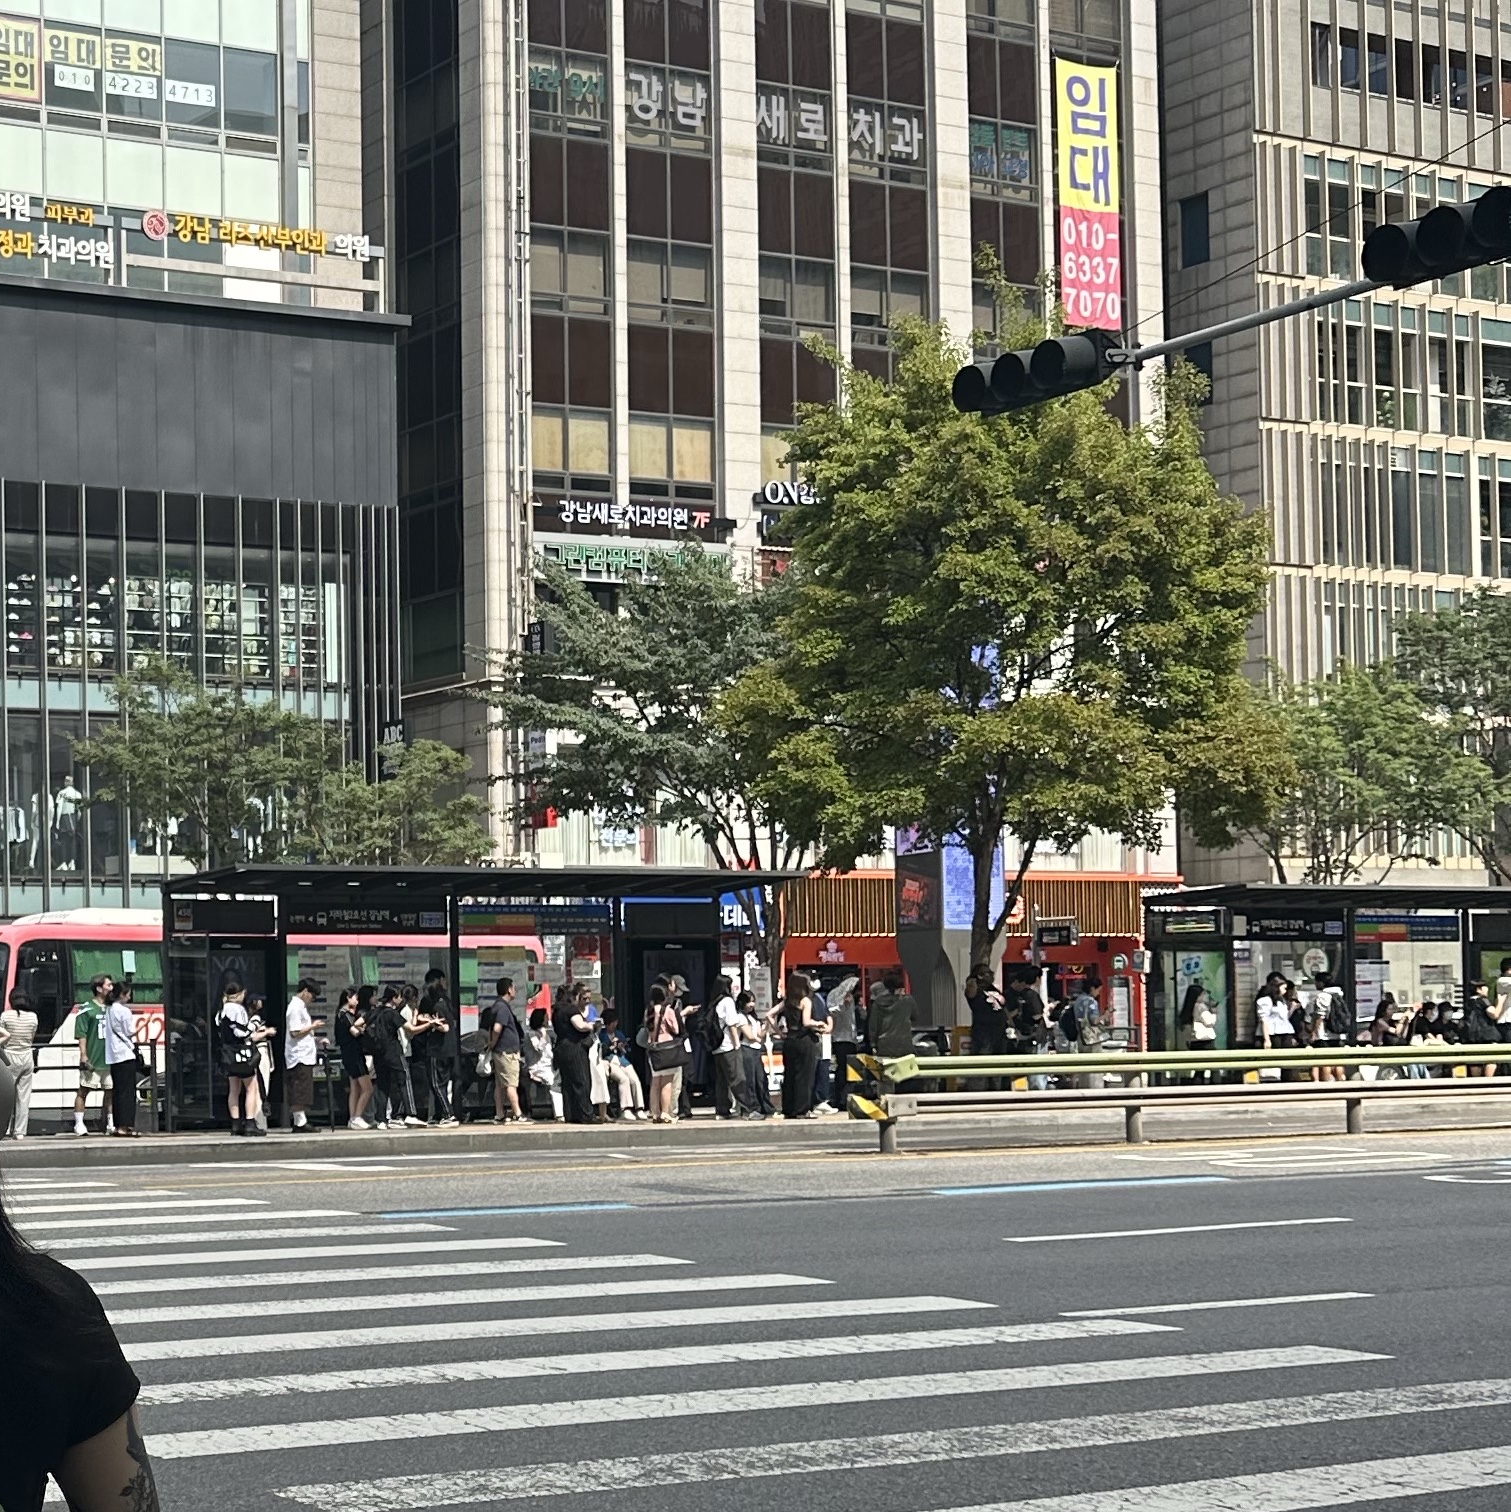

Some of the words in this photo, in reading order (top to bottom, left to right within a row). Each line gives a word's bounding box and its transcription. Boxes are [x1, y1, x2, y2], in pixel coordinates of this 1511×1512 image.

[49, 34, 96, 66] 임대
[111, 43, 157, 73] 문의
[58, 70, 91, 86] 010
[108, 76, 154, 95] 4223
[168, 84, 213, 103] 4713
[629, 72, 707, 127] 강남
[756, 95, 828, 143] 새로
[850, 108, 924, 160] 치과
[1066, 75, 1111, 207] 임대
[46, 205, 95, 227] 피부과
[175, 214, 212, 244] 강남
[334, 233, 371, 262] 의원
[1063, 217, 1119, 250] 010-
[39, 234, 114, 269] 치과의원
[1064, 251, 1120, 285] 6337
[1064, 287, 1120, 321] 7070
[559, 500, 688, 530] 강남새로치과의원
[692, 511, 711, 528] 7F
[383, 724, 403, 745] ABC
